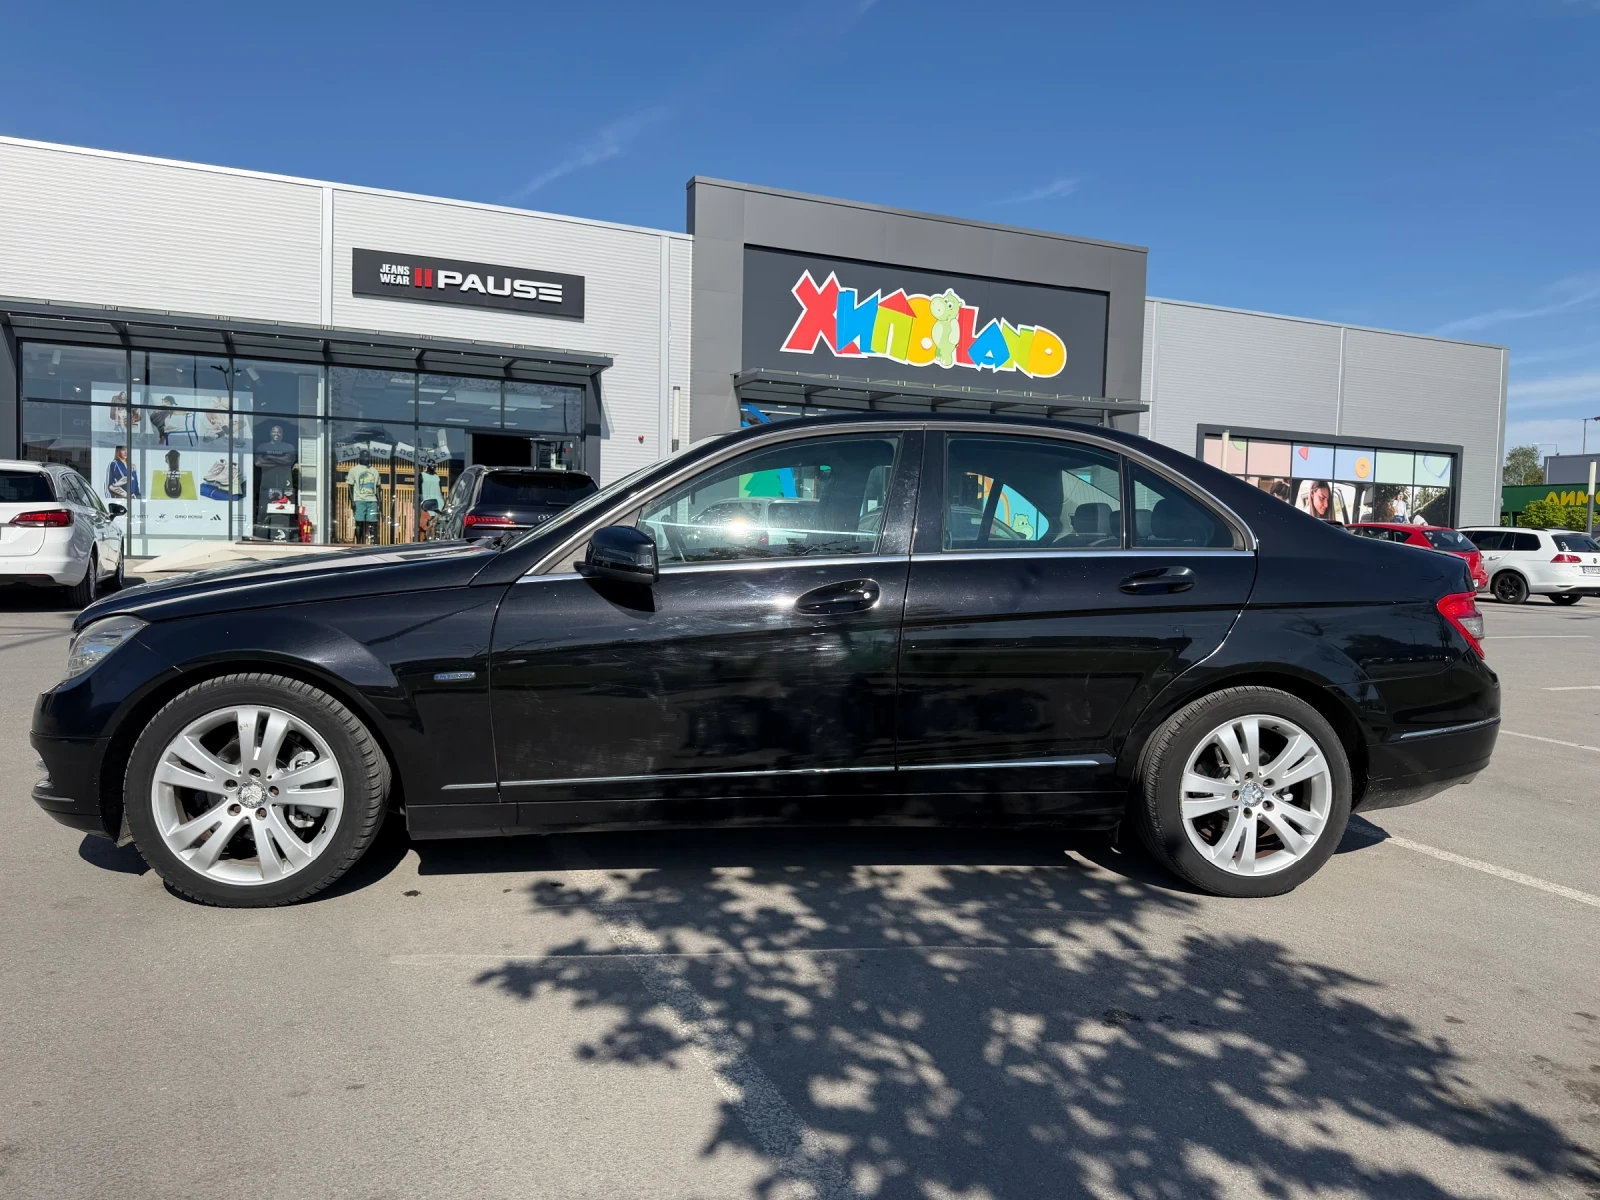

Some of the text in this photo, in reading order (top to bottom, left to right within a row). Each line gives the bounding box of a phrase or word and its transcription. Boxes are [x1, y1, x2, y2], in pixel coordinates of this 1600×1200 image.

[380, 263, 410, 276] JEANS
[379, 273, 410, 286] WEAR
[437, 269, 563, 303] PAUSE
[373, 446, 388, 456] we
